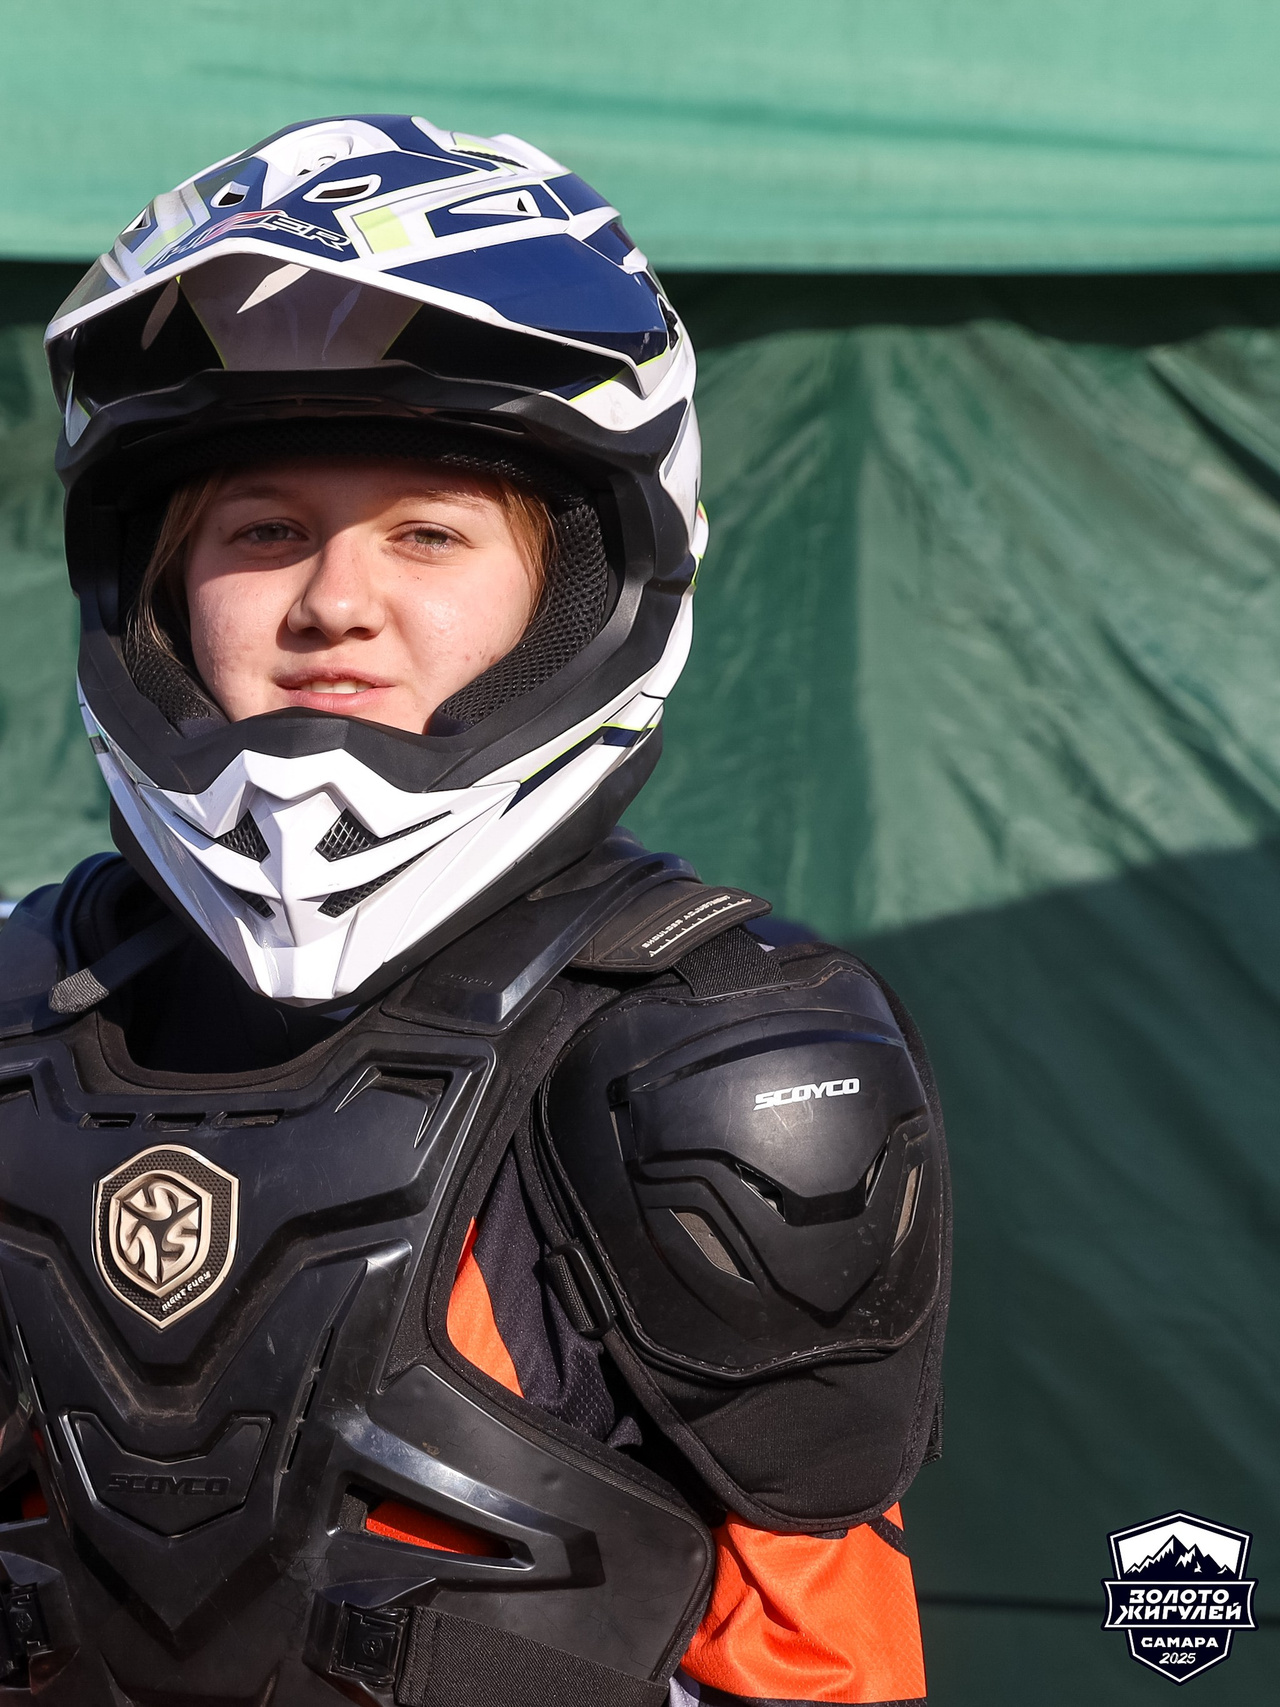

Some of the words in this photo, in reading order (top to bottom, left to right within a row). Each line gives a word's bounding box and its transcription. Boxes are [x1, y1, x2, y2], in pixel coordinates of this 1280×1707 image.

[641, 919, 683, 948] SHOULDER
[753, 1077, 860, 1110] SCOYCO
[161, 1288, 187, 1312] NIGHT
[187, 1270, 211, 1292] FURY
[107, 1472, 231, 1495] SCOYCO
